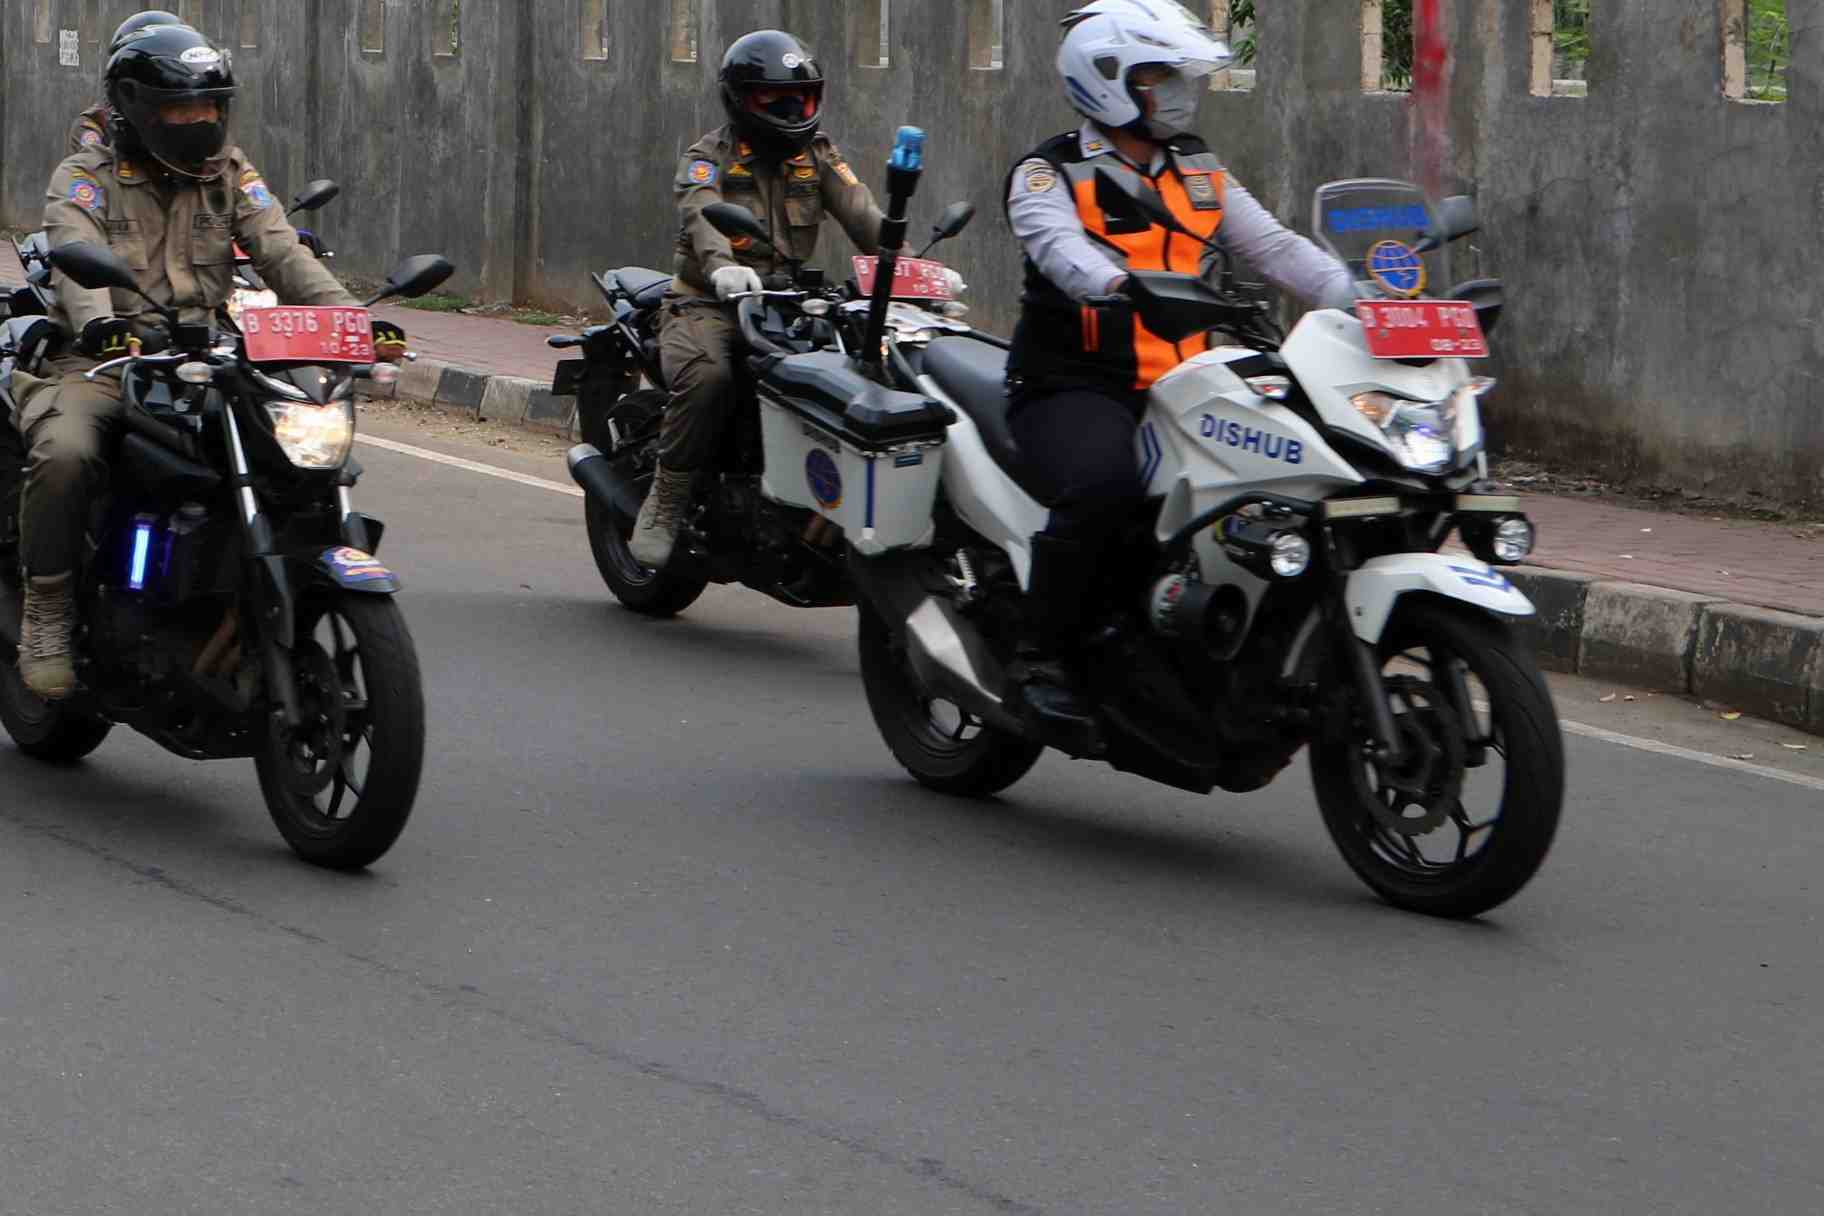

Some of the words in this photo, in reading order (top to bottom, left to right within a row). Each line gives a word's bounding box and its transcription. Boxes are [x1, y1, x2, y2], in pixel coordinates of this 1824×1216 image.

[245, 312, 258, 333] B
[270, 311, 318, 333] 3376
[1200, 413, 1302, 464] DISHUB
